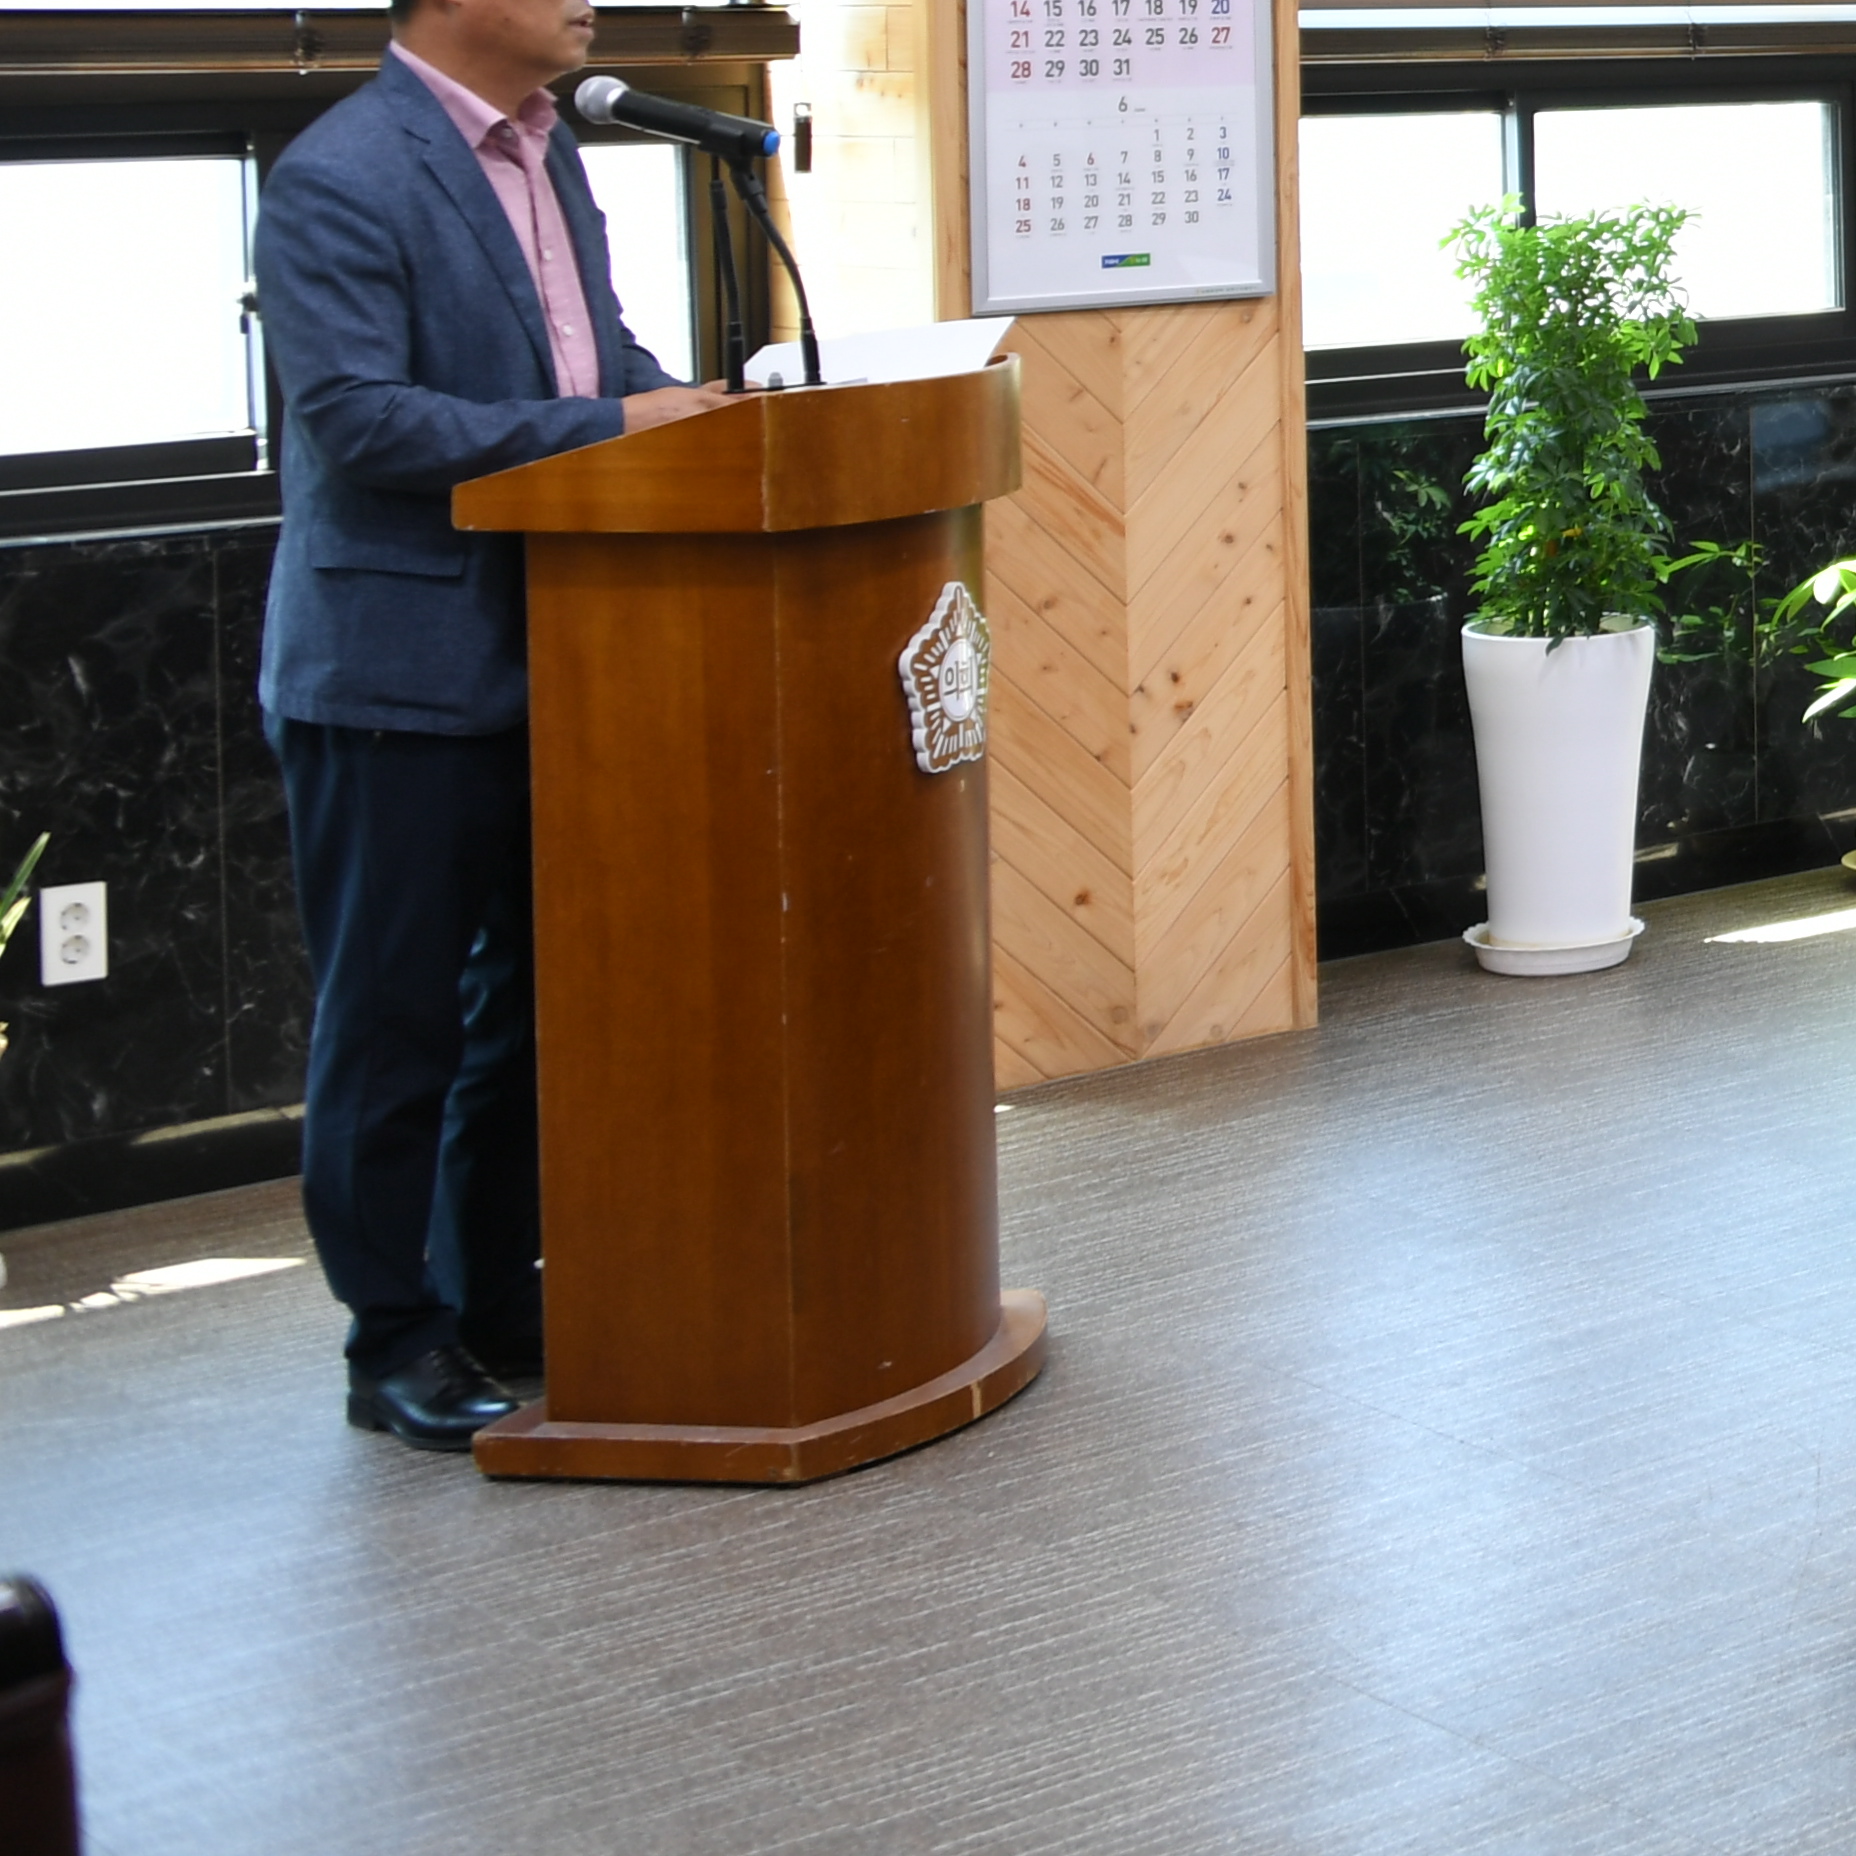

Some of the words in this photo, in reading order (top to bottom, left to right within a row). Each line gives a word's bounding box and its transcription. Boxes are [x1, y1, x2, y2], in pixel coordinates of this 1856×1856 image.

[1010, 0, 1031, 17] 14
[1043, 0, 1063, 17] 15
[1078, 0, 1097, 17] 16
[1010, 30, 1029, 49] 21
[1044, 29, 1065, 48] 22
[1078, 29, 1099, 47] 23
[1113, 28, 1132, 46] 24
[1145, 27, 1165, 46] 25
[1179, 27, 1199, 45] 26
[1211, 26, 1231, 44] 27
[1011, 60, 1032, 79] 28
[1045, 60, 1065, 78] 29
[1079, 59, 1100, 77] 30
[1113, 58, 1130, 76] 31
[1117, 96, 1128, 113] 6
[1217, 146, 1230, 160] 10
[1016, 176, 1029, 190] 11
[1050, 175, 1064, 189] 12
[1084, 173, 1098, 187] 13
[1118, 172, 1131, 185] 14
[1151, 170, 1165, 184] 15
[1184, 169, 1198, 182] 16
[1217, 167, 1230, 181] 17
[1016, 198, 1031, 211] 18
[1050, 196, 1064, 209] 19
[1084, 194, 1099, 209] 20
[1118, 192, 1131, 207] 21
[1151, 191, 1166, 205] 22
[1184, 189, 1199, 203] 23
[1217, 188, 1232, 202] 24
[1015, 219, 1032, 234] 25
[1050, 217, 1065, 232] 26
[1084, 215, 1099, 230] 27
[1118, 214, 1133, 228] 28
[1151, 212, 1167, 226] 29
[1184, 210, 1200, 224] 30
[943, 657, 973, 701] 의회
